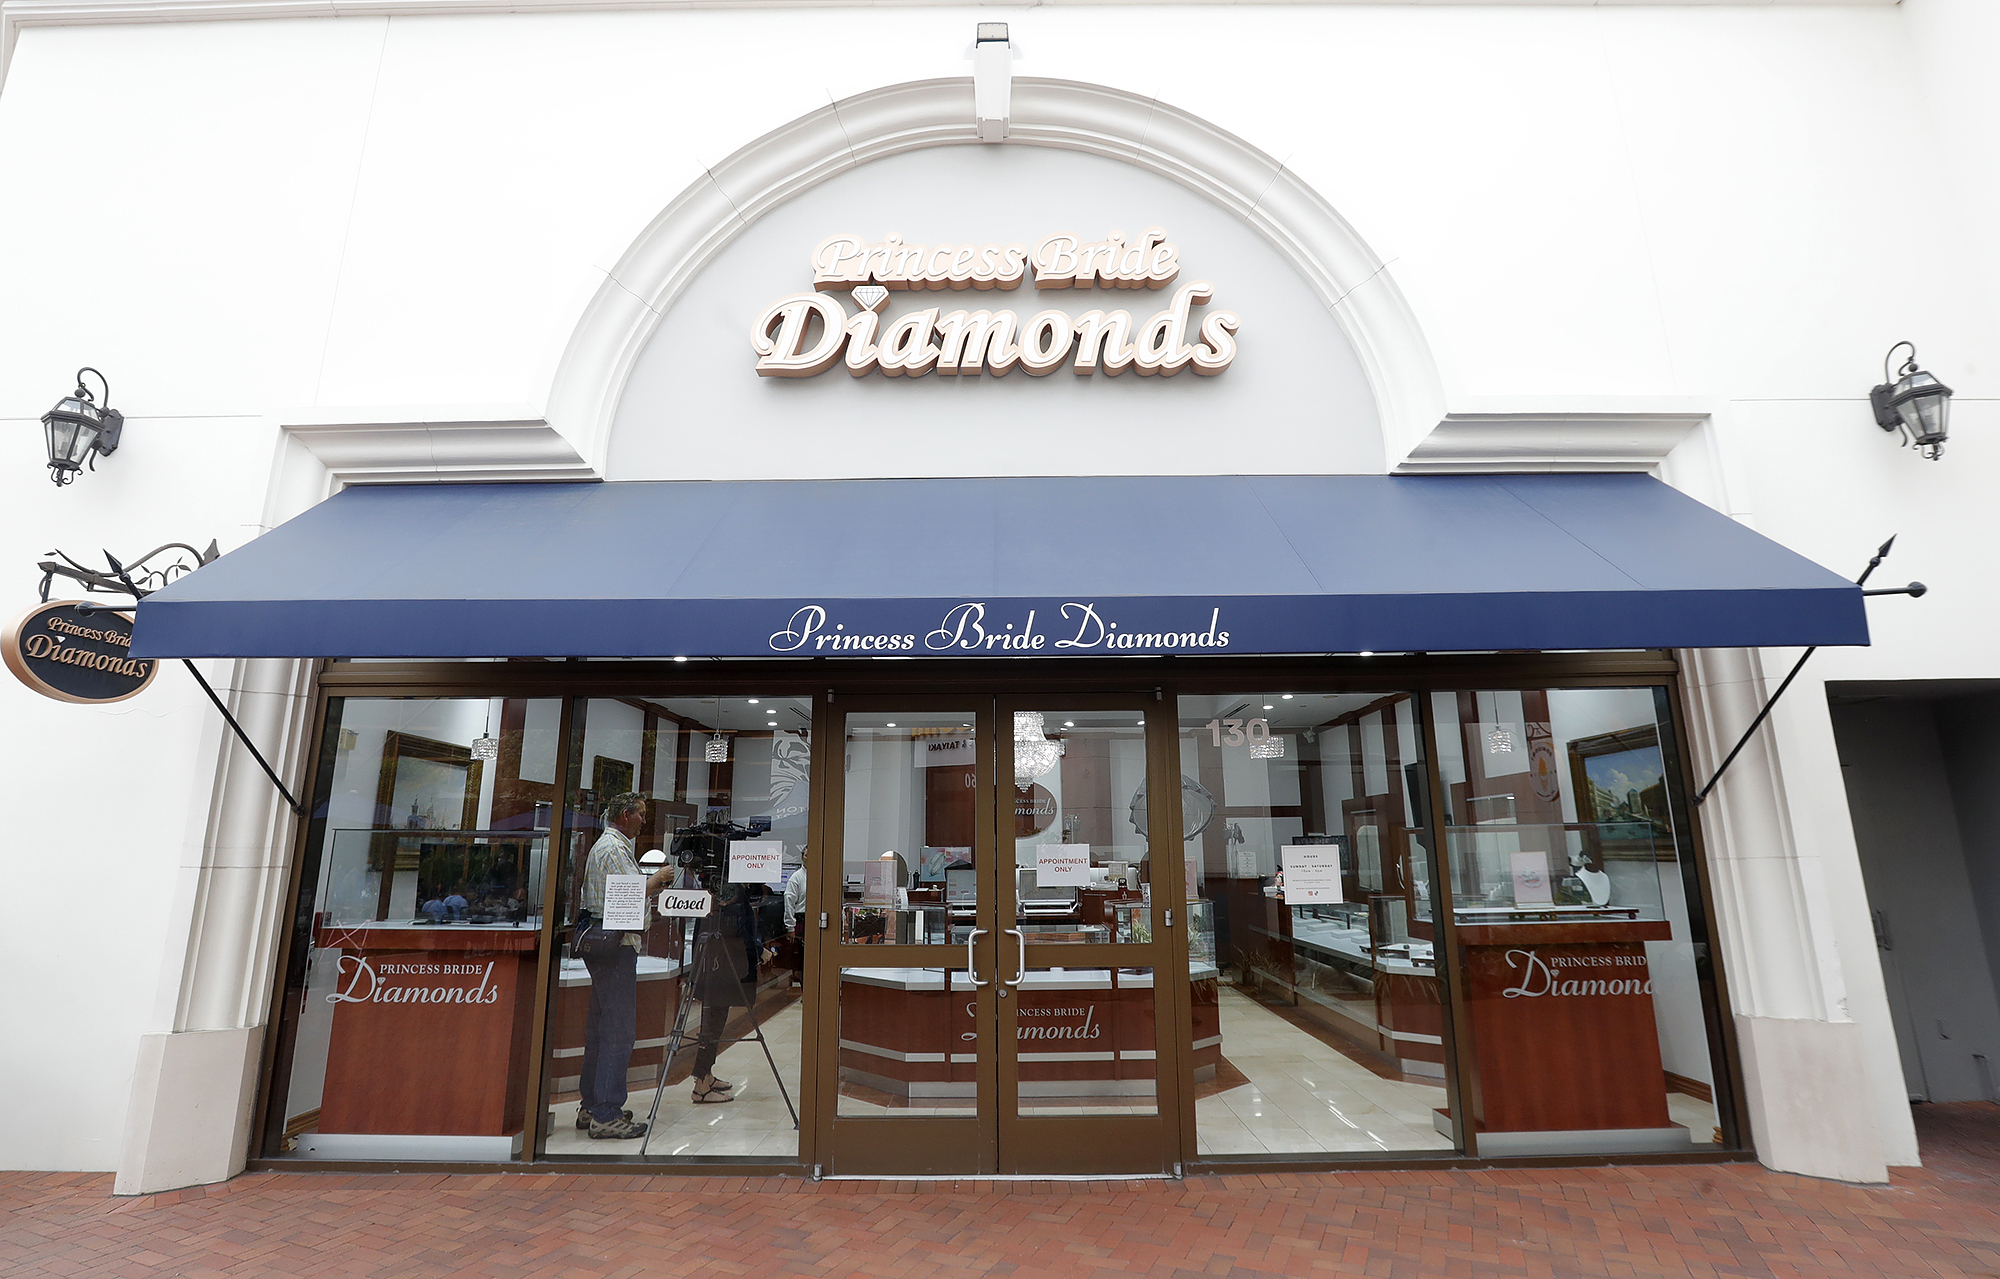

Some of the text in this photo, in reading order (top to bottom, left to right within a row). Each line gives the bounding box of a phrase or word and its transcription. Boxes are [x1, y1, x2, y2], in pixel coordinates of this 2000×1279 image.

[813, 226, 1181, 291] Princess Bride
[750, 280, 1243, 378] Diamonds
[47, 617, 133, 648] Princess Brid
[769, 602, 1230, 652] Princess Bride Diamonds
[25, 634, 148, 678] Diamonds
[1206, 718, 1270, 747] 130
[1014, 797, 1054, 815] monds
[665, 895, 705, 910] Closed
[379, 964, 482, 975] PRINCESS BRIDE
[1502, 949, 1654, 998] Diamon
[1551, 955, 1647, 968] PRINCESS BRID
[325, 955, 498, 1004] Diamonds
[961, 1002, 1100, 1040] monds
[1016, 1007, 1086, 1017] INCESS BRIDE
